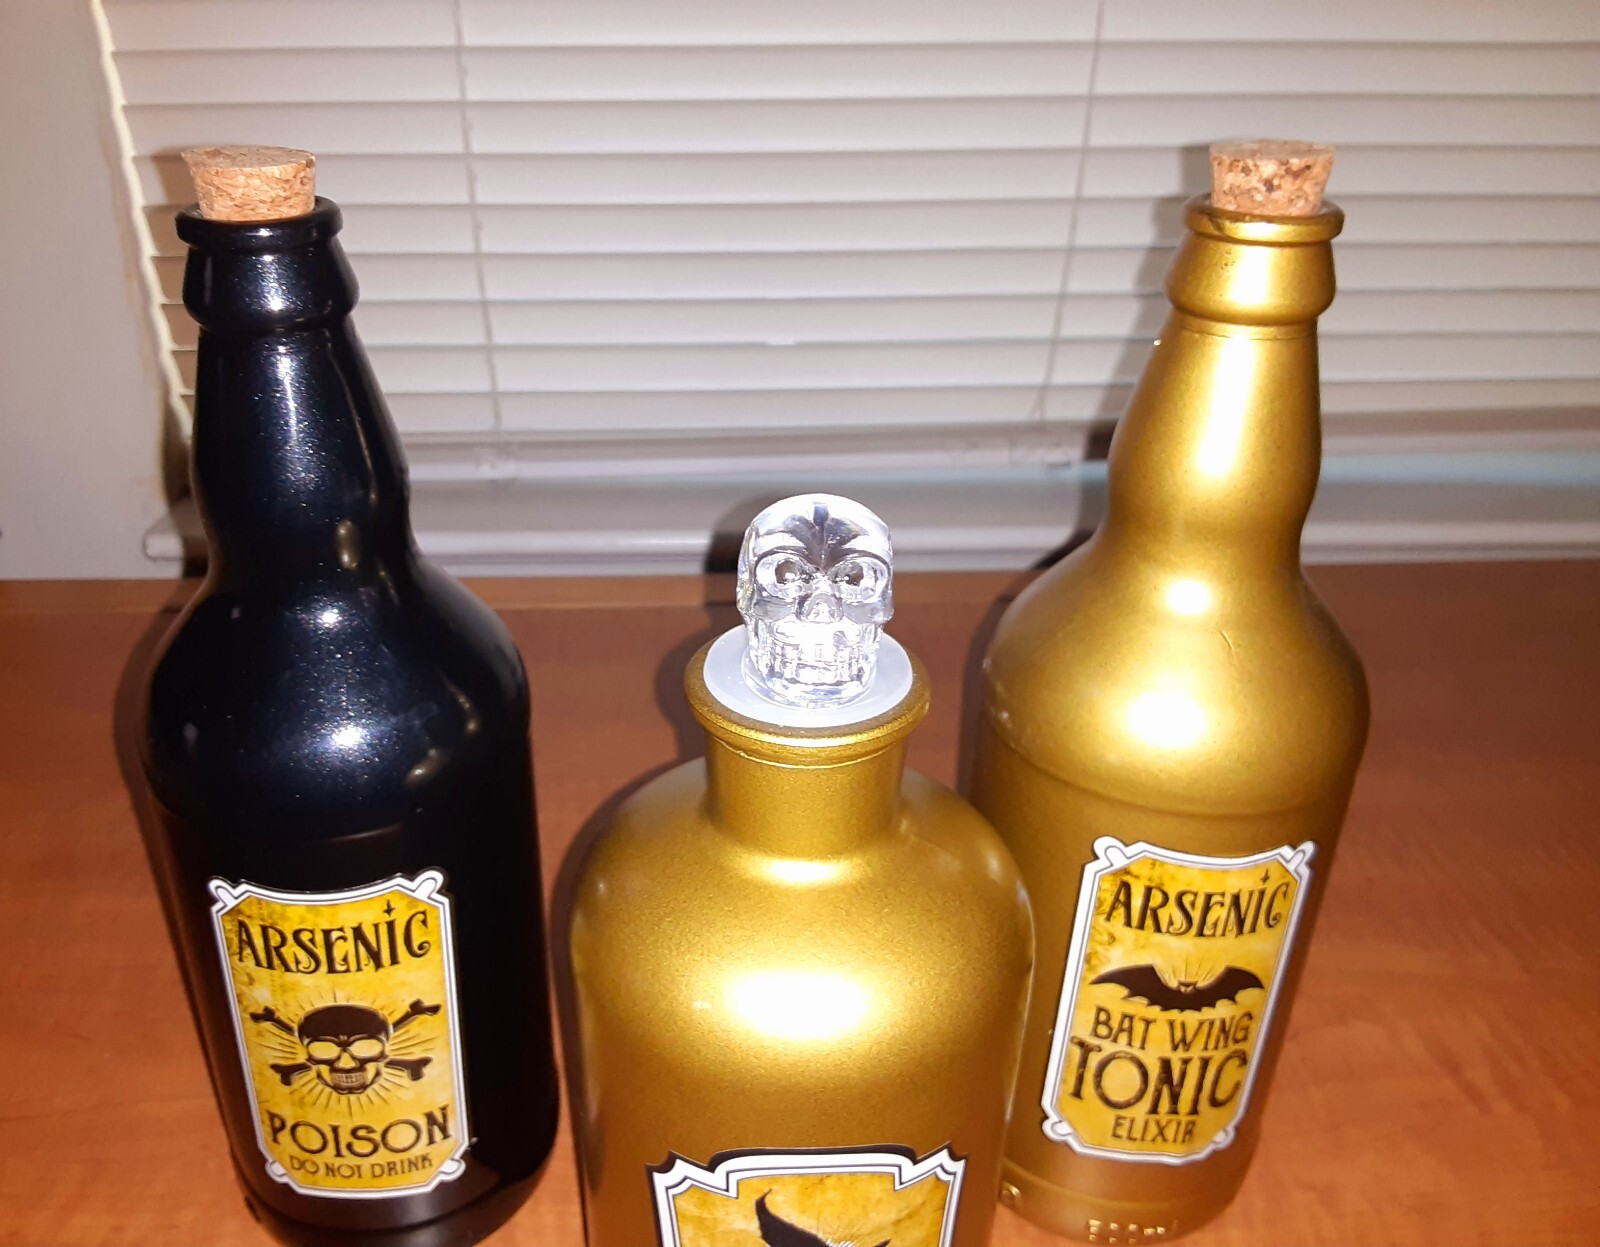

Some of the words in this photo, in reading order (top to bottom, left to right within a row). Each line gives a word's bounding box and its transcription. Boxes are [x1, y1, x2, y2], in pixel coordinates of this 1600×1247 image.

[1103, 869, 1290, 938] ARSENIC
[236, 902, 432, 975] ARSENIC
[1089, 1005, 1157, 1051] BAT
[1167, 1012, 1254, 1052] WING
[1069, 1035, 1248, 1116] TONIC
[264, 1104, 453, 1158] POISON
[1111, 1115, 1197, 1144] ELIXIR
[289, 1154, 320, 1175] DO
[324, 1161, 363, 1179] NOT
[371, 1152, 433, 1179] DRINK
